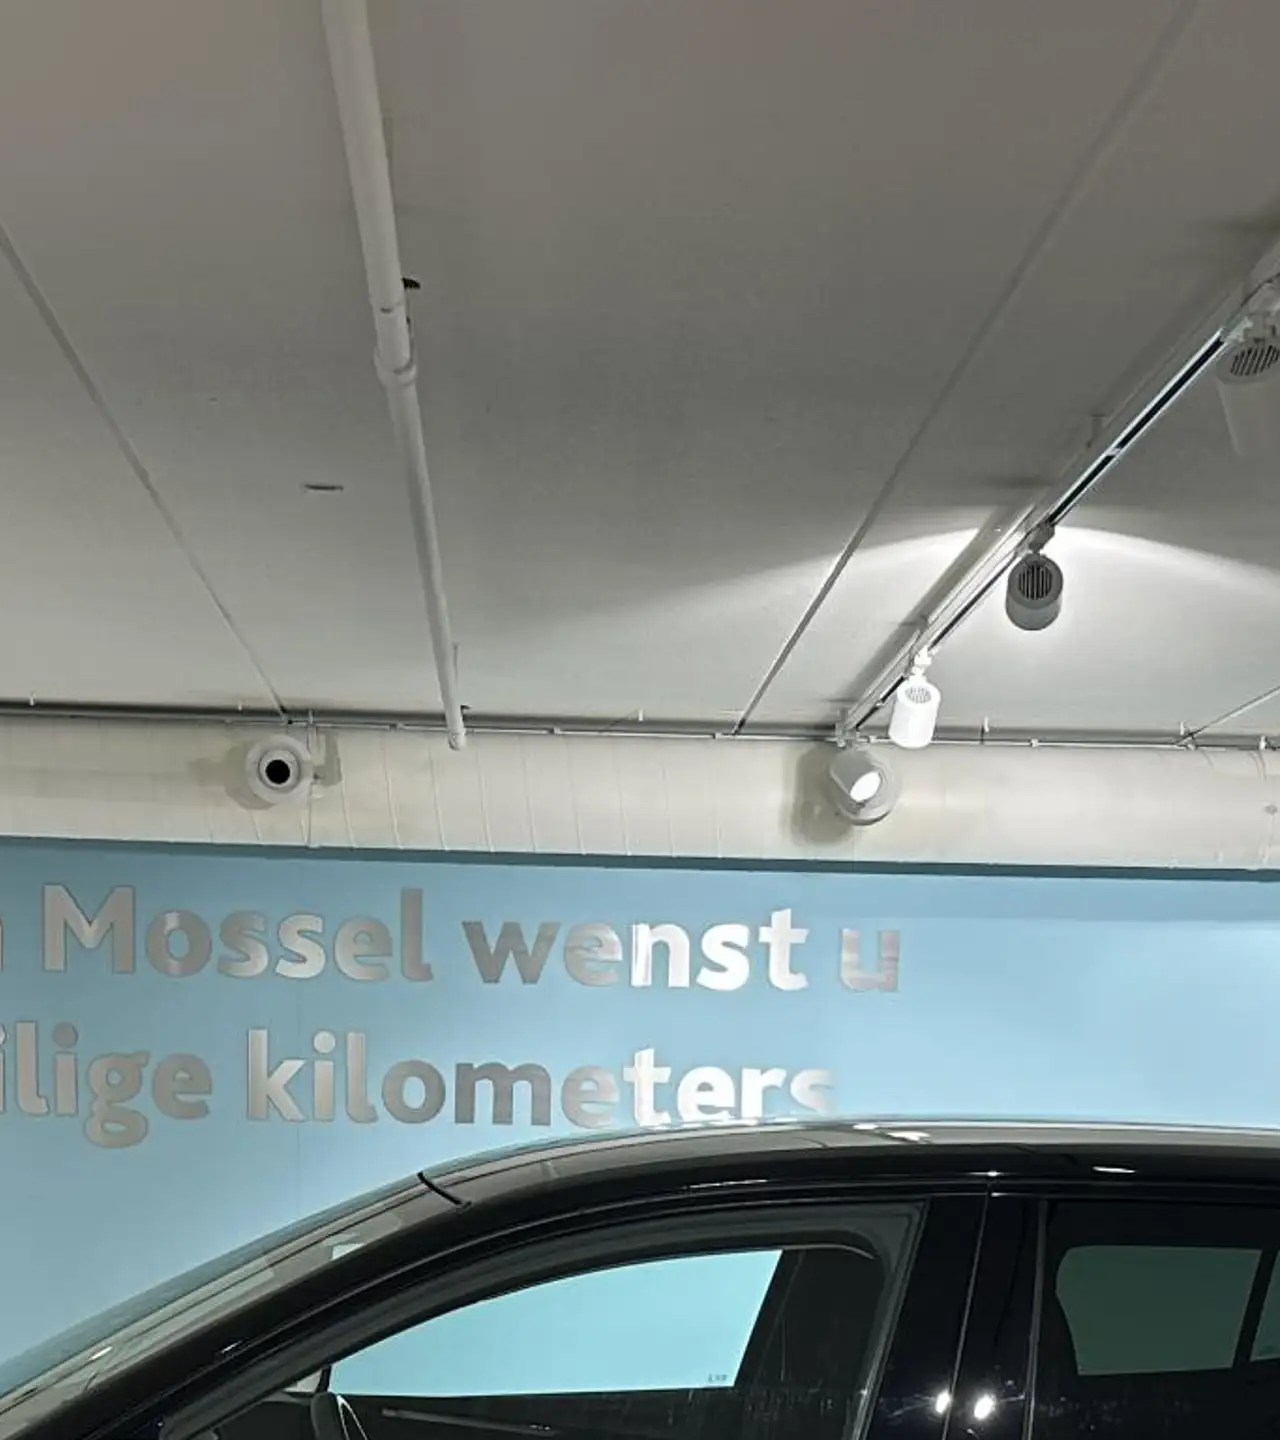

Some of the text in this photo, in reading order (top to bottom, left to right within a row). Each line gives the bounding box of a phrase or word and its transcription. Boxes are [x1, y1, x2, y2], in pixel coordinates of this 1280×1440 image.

[42, 883, 433, 982] Mossel
[461, 907, 809, 992] wenst
[840, 926, 900, 992] u
[246, 1028, 838, 1127] kilometers
